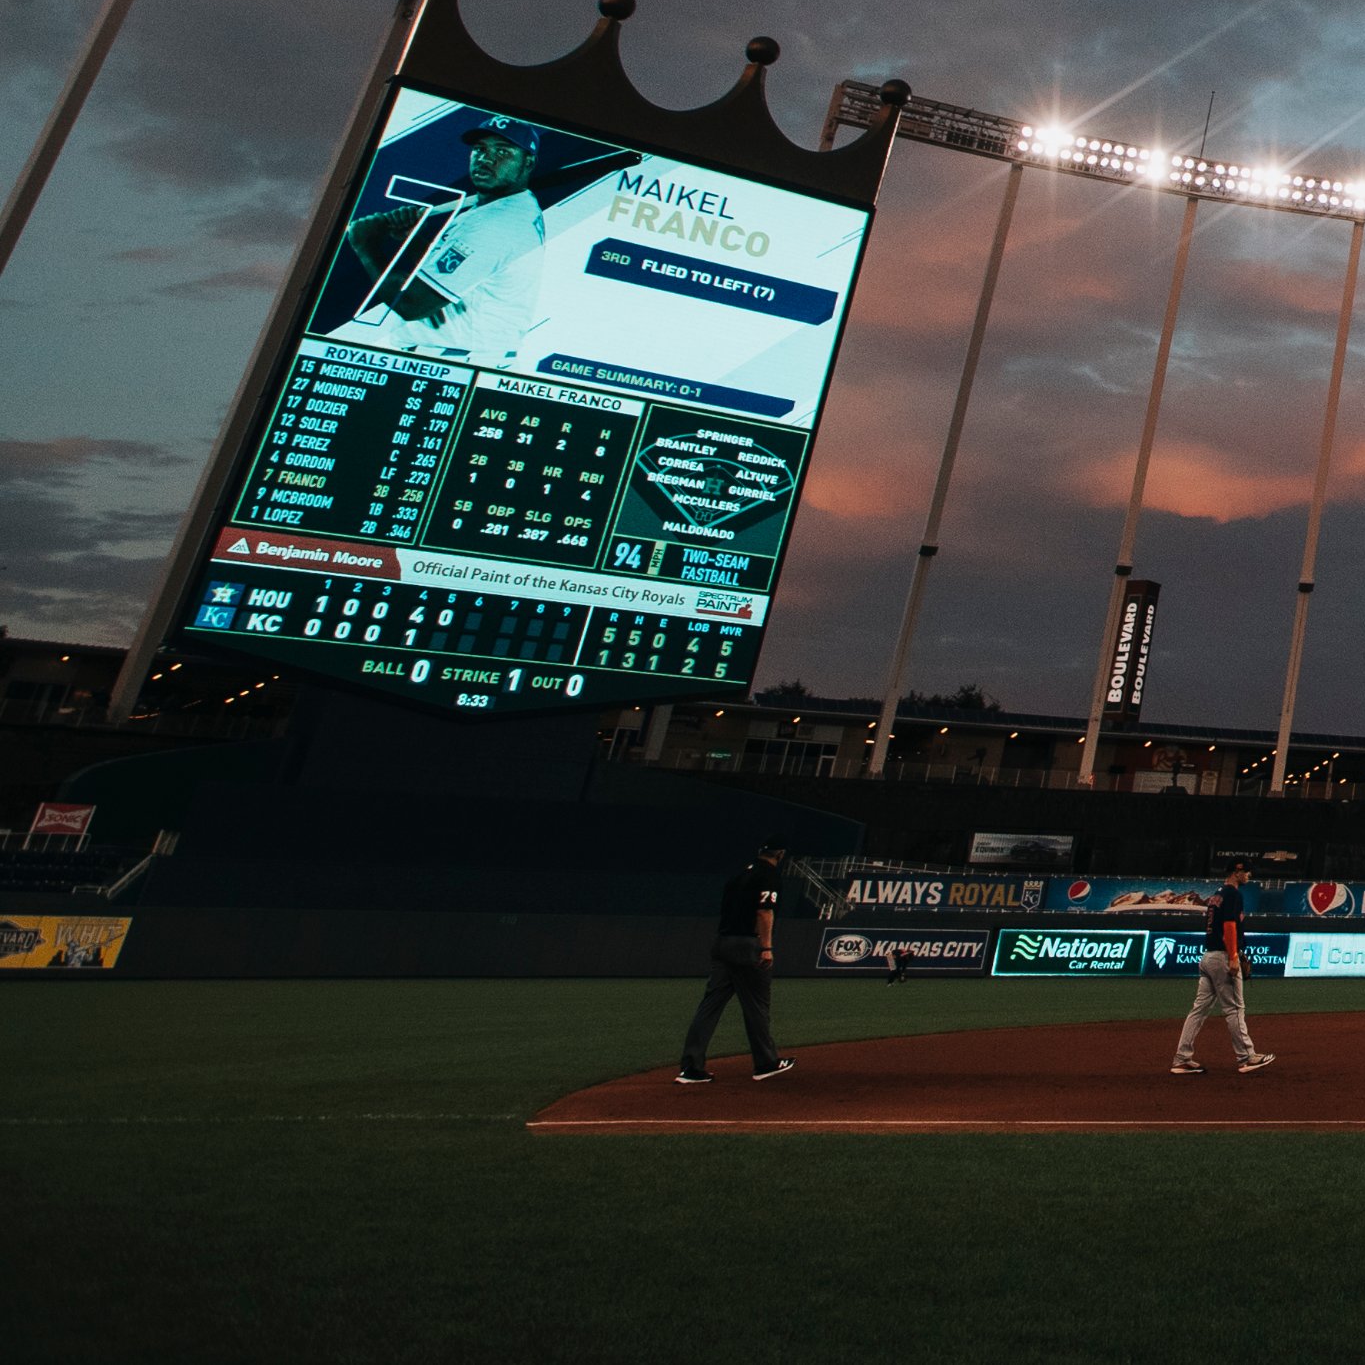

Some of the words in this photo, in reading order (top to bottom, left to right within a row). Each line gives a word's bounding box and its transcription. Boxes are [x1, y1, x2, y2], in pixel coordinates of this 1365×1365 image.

[617, 168, 733, 219] MAIKEL
[607, 194, 769, 257] FRANCO
[601, 250, 630, 265] 3RD
[641, 258, 687, 278] FLIED
[690, 270, 711, 284] TO
[713, 275, 752, 293] LEFT
[752, 285, 774, 301] (7)
[324, 346, 388, 367] ROYALS
[391, 358, 450, 378] LINEUP
[300, 359, 316, 372] 15
[319, 362, 388, 385] MERRIFIELD
[551, 359, 593, 376] GAME
[595, 368, 677, 392] SUMMARY:
[679, 384, 701, 397] 0-1
[292, 377, 310, 390] 27
[312, 380, 366, 400] MONDESI
[497, 378, 553, 398] MAIKEL
[558, 389, 621, 410] FRANCO
[286, 394, 302, 408] 17
[305, 398, 348, 416] DOZIER
[280, 412, 295, 426] 12
[298, 416, 338, 433] SOLER
[272, 430, 287, 444] 13
[291, 433, 330, 451] PEREZ
[653, 437, 717, 455] BRANTLEY
[695, 428, 753, 447] SPRINGER
[284, 452, 335, 470] GORDON
[657, 456, 703, 472] CORREA
[737, 451, 786, 468] REDDICK
[277, 470, 326, 488] FRANCO
[646, 471, 705, 489] BREGMAN
[734, 469, 778, 484] ALTUVE
[270, 488, 333, 508] MCBROOM
[670, 493, 740, 512] MCCULLERS
[728, 485, 778, 501] GURRIEL
[263, 507, 303, 524] LOPEZ
[662, 521, 734, 539] MALDONADO
[255, 541, 329, 561] Benjamin
[332, 550, 382, 567] Moore
[613, 542, 641, 568] 94
[682, 548, 749, 570] TWO-SEAM
[412, 560, 462, 578] Official
[470, 567, 511, 584] Paint
[513, 574, 531, 586] of
[532, 575, 556, 589] the
[559, 579, 608, 595] Kansas
[611, 585, 639, 602] City
[641, 589, 685, 605] Royals
[681, 565, 739, 586] FASTBALL
[247, 588, 292, 608] HOU
[695, 597, 741, 614] PAINT
[698, 590, 752, 605] SPECTRUM
[246, 613, 282, 631] KC
[1107, 602, 1138, 703] BOULEVARD
[1131, 604, 1155, 705] BOULEVARD
[361, 660, 404, 675] BALL
[440, 667, 500, 683] STRIKE
[531, 675, 563, 689] OUT
[456, 693, 488, 707] 8:33
[47, 813, 82, 823] SONIC
[759, 890, 777, 903] 79
[847, 879, 944, 905] ALWAYS
[949, 882, 1021, 907] ROYAL
[836, 940, 864, 951] FOX
[943, 942, 983, 958] CITY
[1038, 936, 1133, 958] National
[1177, 945, 1196, 954] THE
[1257, 945, 1270, 954] OF
[1068, 960, 1087, 969] Car
[1089, 960, 1125, 970] Rental
[1253, 955, 1286, 965] SYSTEM
